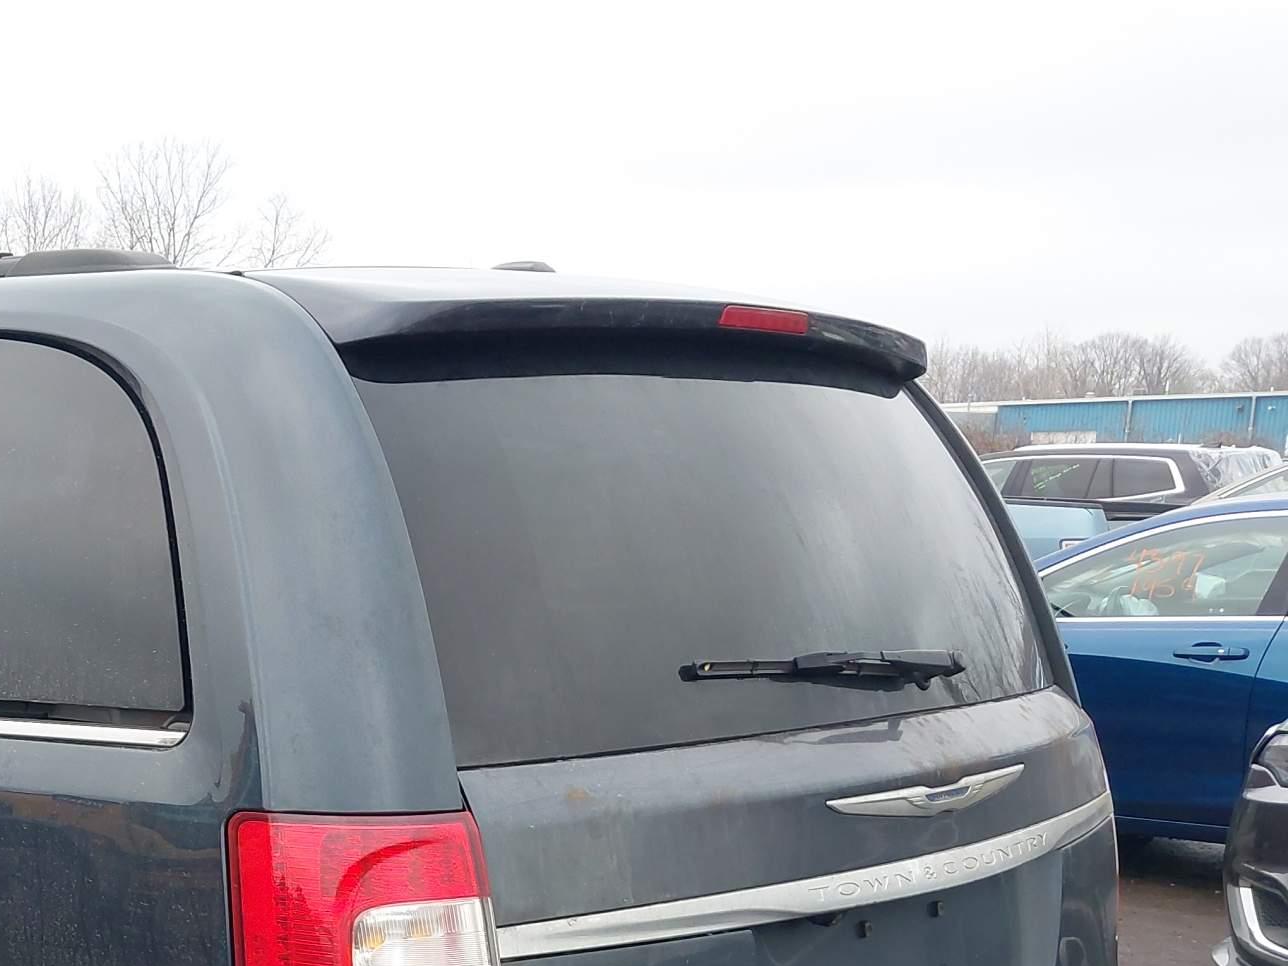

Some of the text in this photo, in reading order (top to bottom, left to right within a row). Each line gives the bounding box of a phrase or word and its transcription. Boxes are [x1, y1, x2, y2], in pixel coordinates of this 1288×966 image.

[807, 831, 1048, 903] TOWN & COUNTRY
